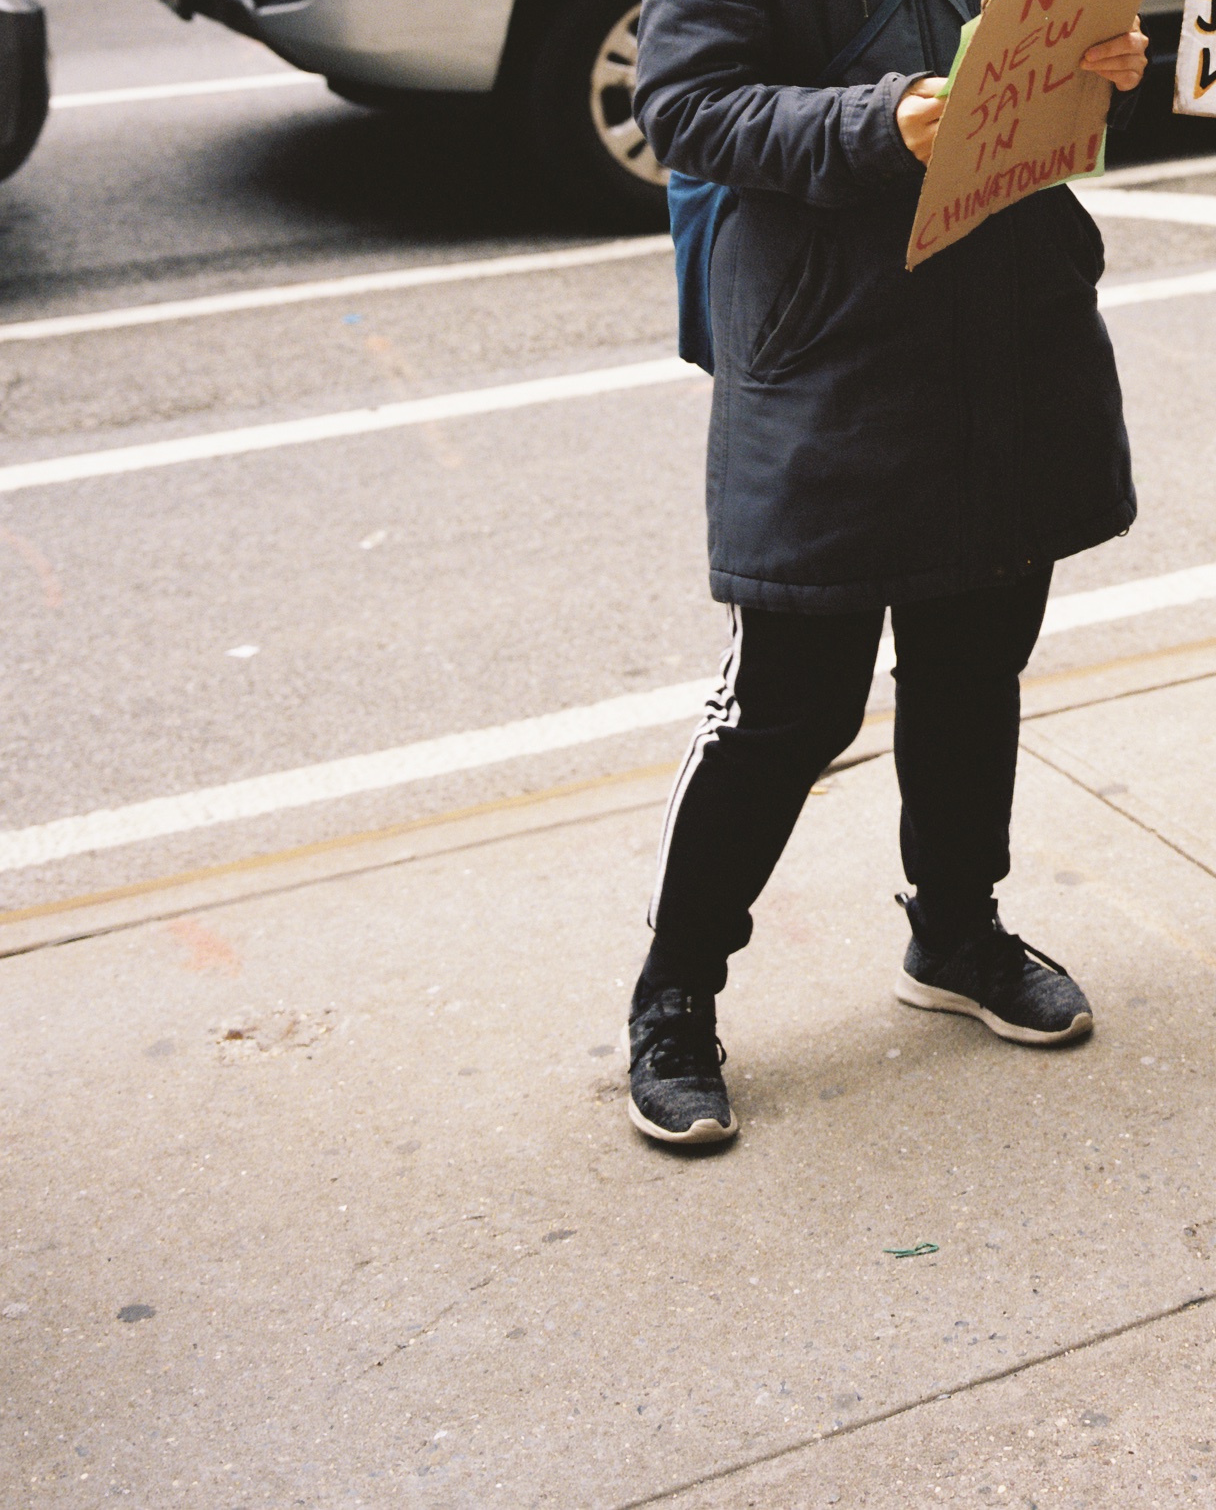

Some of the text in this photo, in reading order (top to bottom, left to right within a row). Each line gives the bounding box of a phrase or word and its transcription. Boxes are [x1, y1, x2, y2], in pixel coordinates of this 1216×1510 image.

[977, 7, 1084, 97] NEW
[966, 63, 1075, 141] JAIL
[974, 118, 1020, 172] IN
